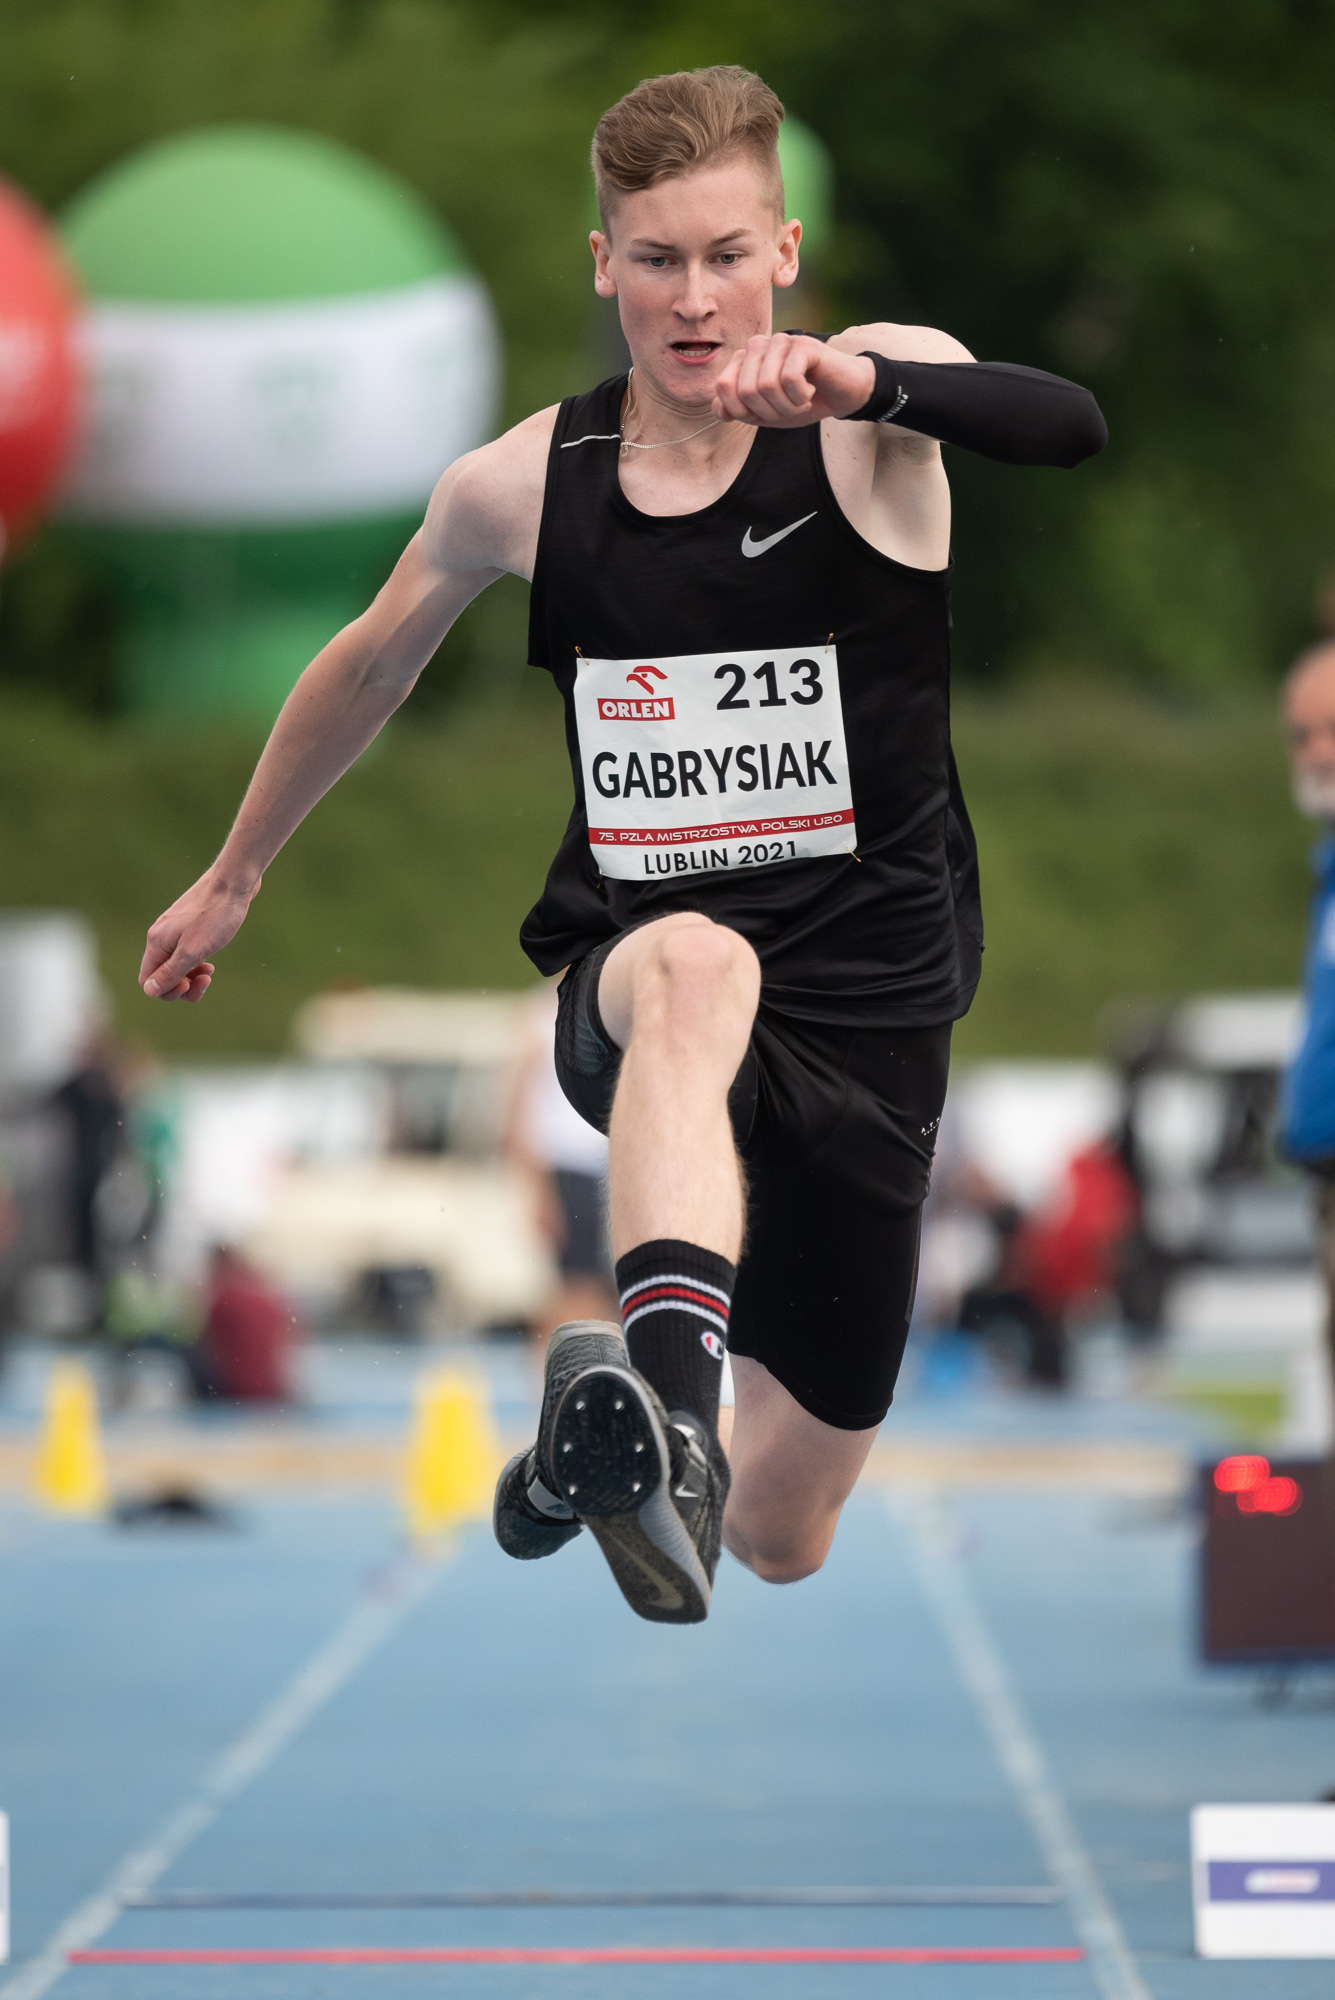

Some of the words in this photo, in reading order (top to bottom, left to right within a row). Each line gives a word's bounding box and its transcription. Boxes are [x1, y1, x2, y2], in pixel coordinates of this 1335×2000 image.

[714, 659, 824, 710] 213
[602, 701, 671, 718] ORLEN
[592, 740, 838, 799] GABRYSIAK
[599, 832, 618, 841] 75.
[620, 832, 655, 842] PZLA
[657, 823, 759, 842] MISTRZOSTWA
[761, 819, 811, 832] POLSKI
[813, 814, 843, 827] U20
[644, 847, 729, 874] LUBLIN
[738, 841, 796, 865] 2021
